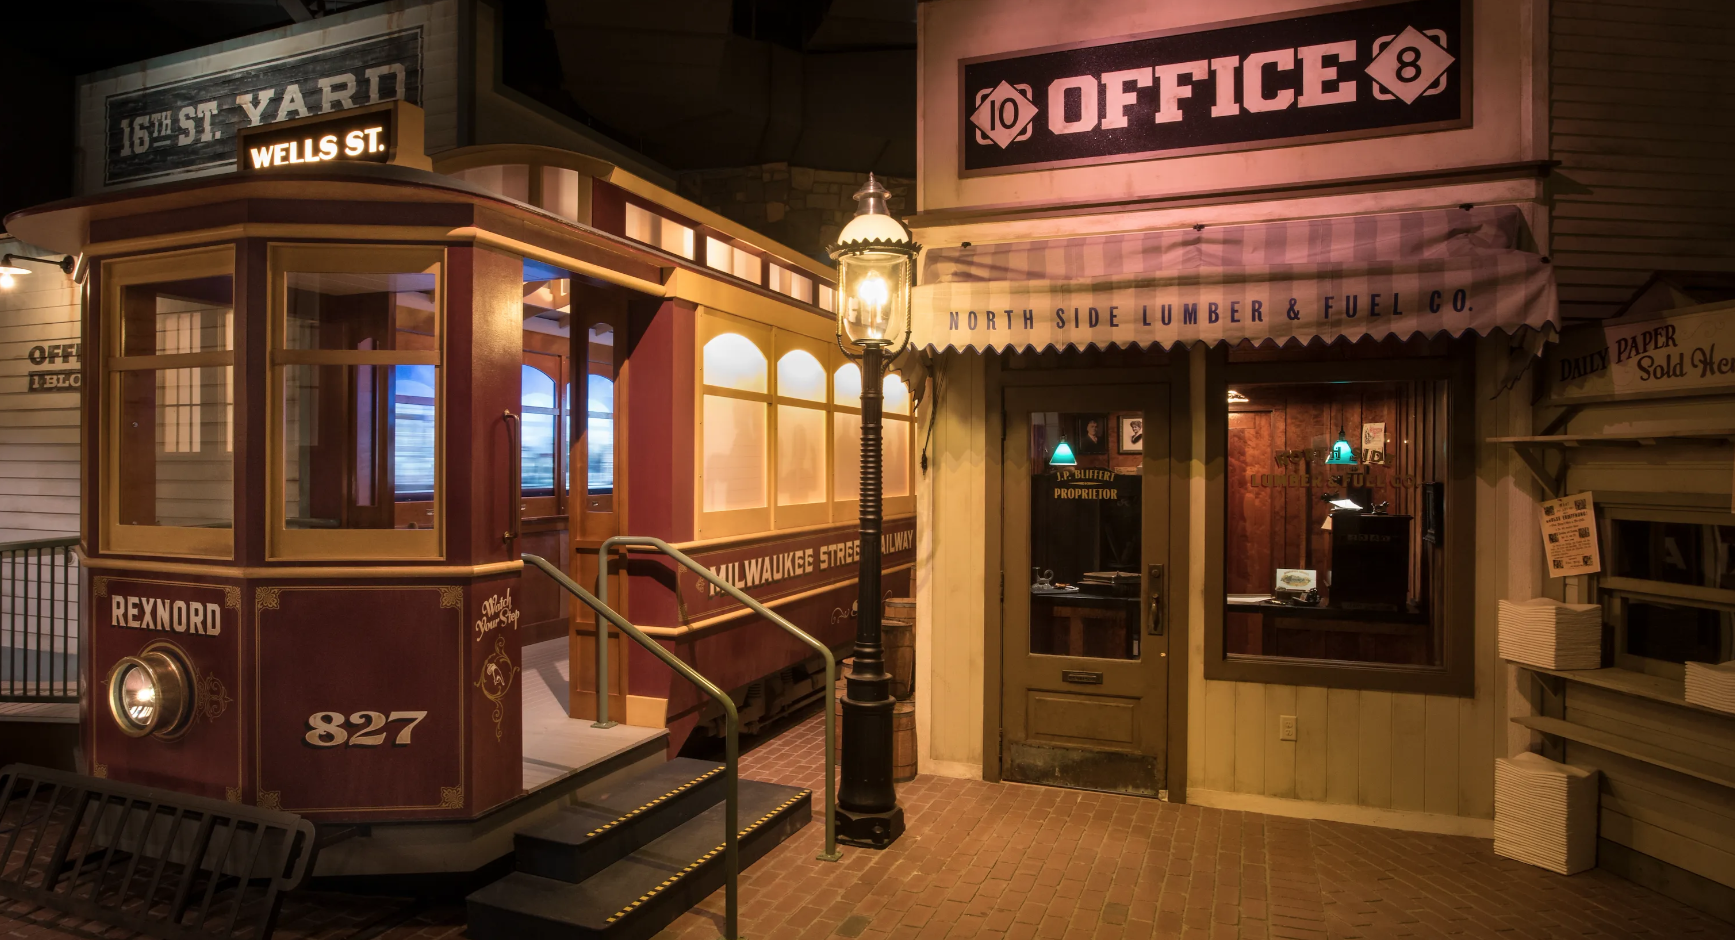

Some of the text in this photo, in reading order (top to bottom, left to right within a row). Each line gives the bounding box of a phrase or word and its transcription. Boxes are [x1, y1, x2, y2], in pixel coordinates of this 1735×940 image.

[989, 40, 1422, 135] 10 OFFICE 8
[120, 63, 406, 157] 16TH ST. YARD
[250, 126, 386, 169] WELLS ST.
[949, 288, 1473, 331] NORTH SIDE LUMBER & FUEL CO.
[1560, 324, 1678, 382] DAILY PAPER
[1636, 352, 1687, 382] Sold
[1054, 487, 1118, 500] PROPRIETOR
[1074, 469, 1116, 482] BLIFFERT
[1251, 473, 1321, 488] LUMBER
[709, 529, 914, 597] MILWAUKEE STREE AILWAY
[111, 594, 221, 636] REXNORD
[482, 587, 512, 618] Watch
[475, 607, 520, 642] Your Step
[305, 710, 428, 747] 827
